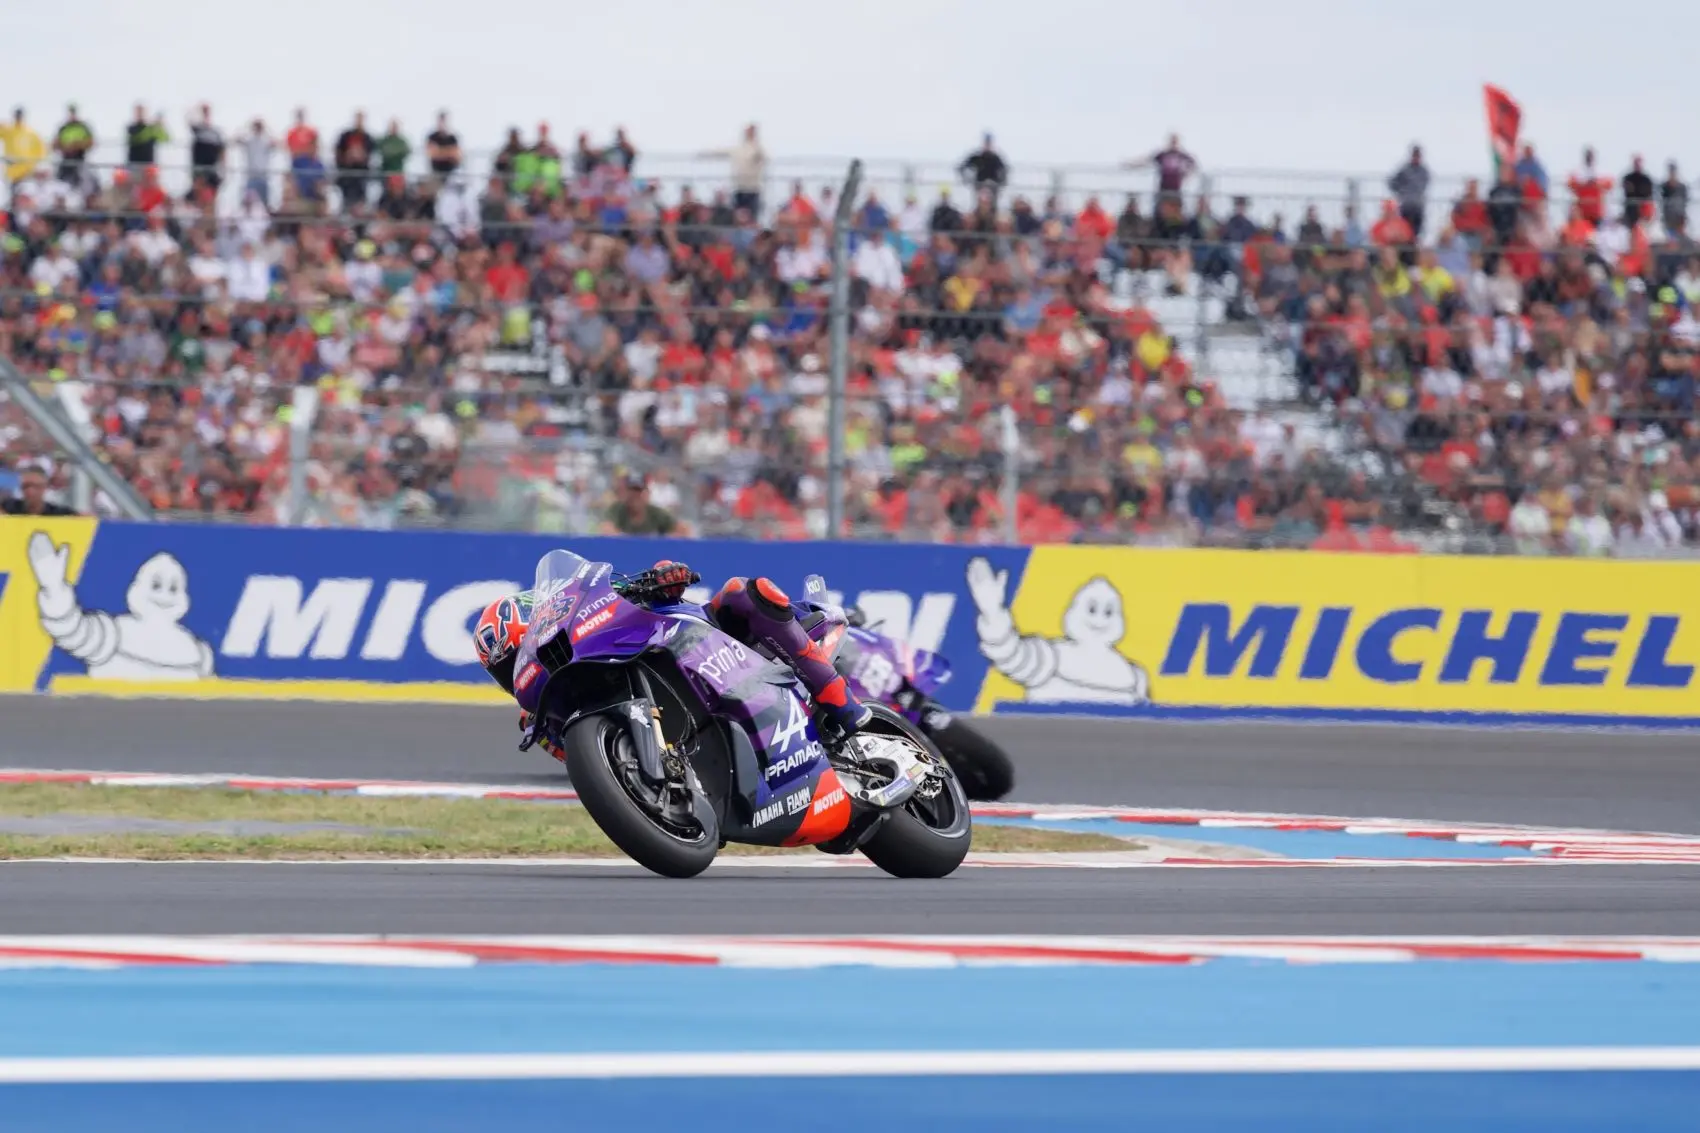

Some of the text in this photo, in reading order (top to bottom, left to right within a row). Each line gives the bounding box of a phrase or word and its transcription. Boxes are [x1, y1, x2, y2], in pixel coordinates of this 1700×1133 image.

[221, 574, 958, 670] MICN
[575, 592, 618, 622] prima
[576, 609, 613, 638] MOTUL
[698, 640, 747, 685] prima
[1159, 602, 1697, 689] MICHEL
[764, 740, 821, 782] PRAMAC
[752, 786, 812, 828] YAMAHA FIAMM
[813, 787, 845, 816] MOTUL
